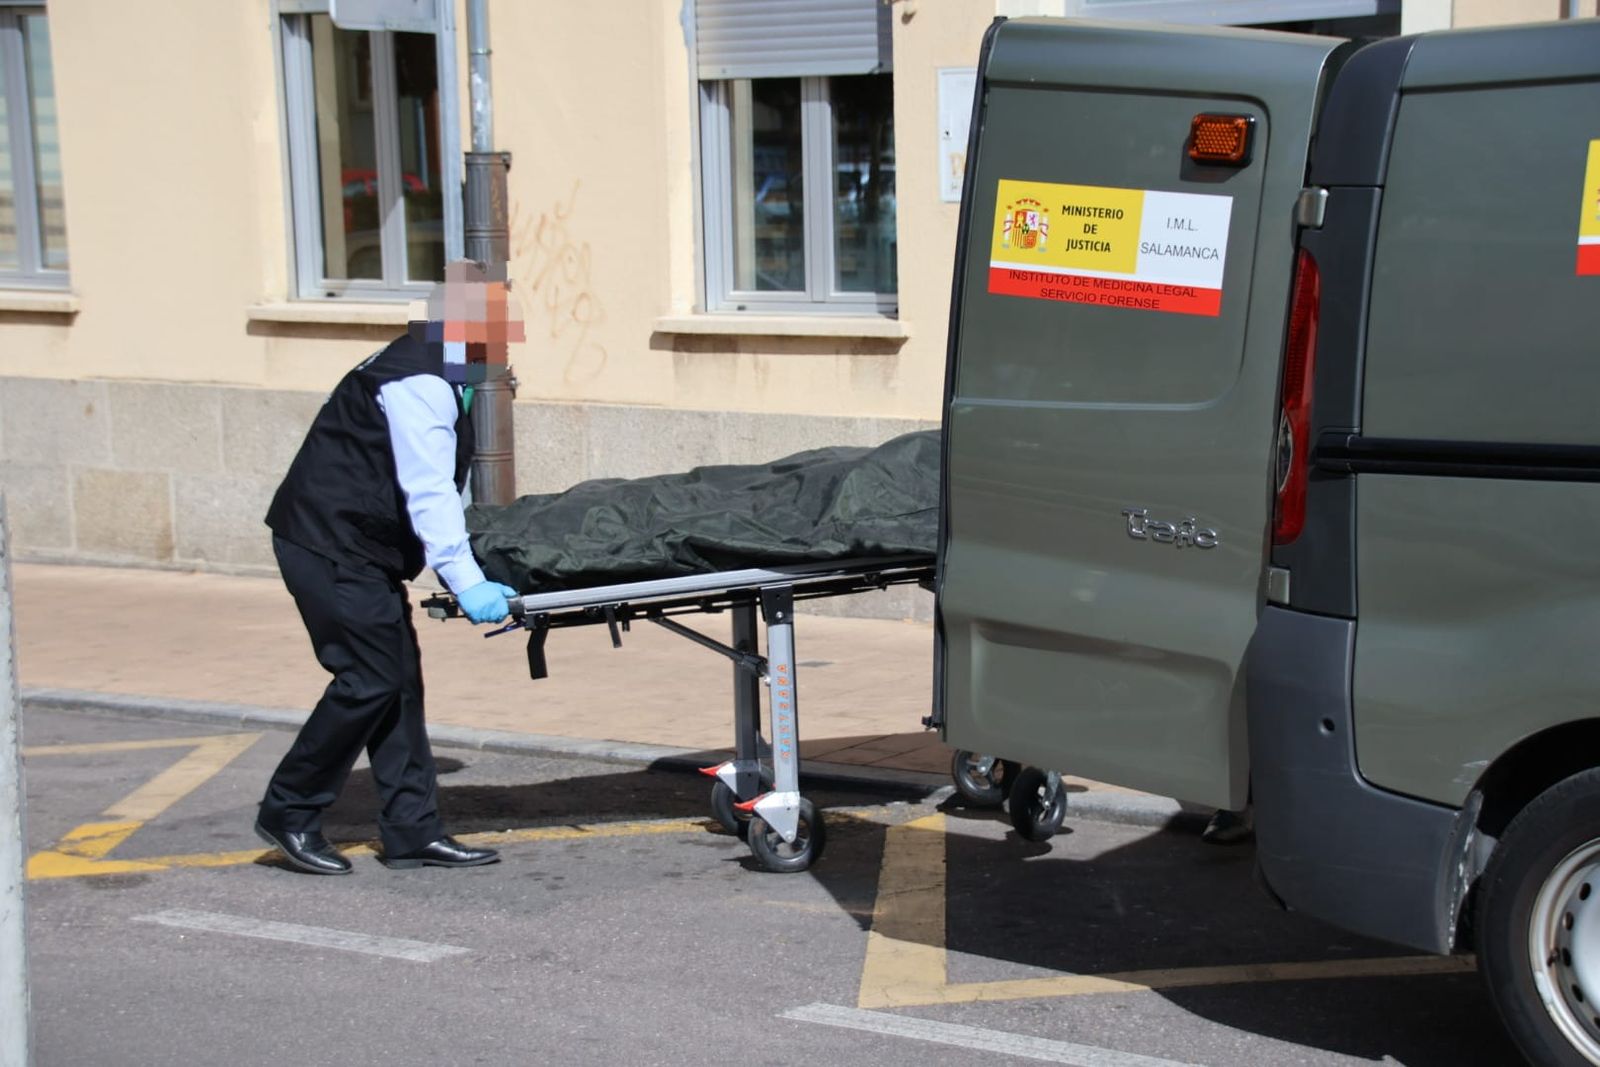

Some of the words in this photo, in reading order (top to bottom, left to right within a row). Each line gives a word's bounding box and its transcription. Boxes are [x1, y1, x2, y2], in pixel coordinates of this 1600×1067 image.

[1062, 205, 1124, 220] MINISTERIO
[1083, 224, 1098, 235] DE
[1166, 217, 1198, 232] I.M.L.
[1066, 239, 1111, 253] JUSTICIA
[1140, 242, 1219, 260] SALAMANCA
[1009, 270, 1070, 286] INSTITUTO
[1073, 276, 1090, 288] DE
[1093, 280, 1153, 294] MEDICINA
[1156, 286, 1197, 298] LEGAL
[1040, 288, 1097, 303] SERVICIO
[1100, 294, 1160, 309] FORENSE
[1121, 507, 1218, 549] Trafic
